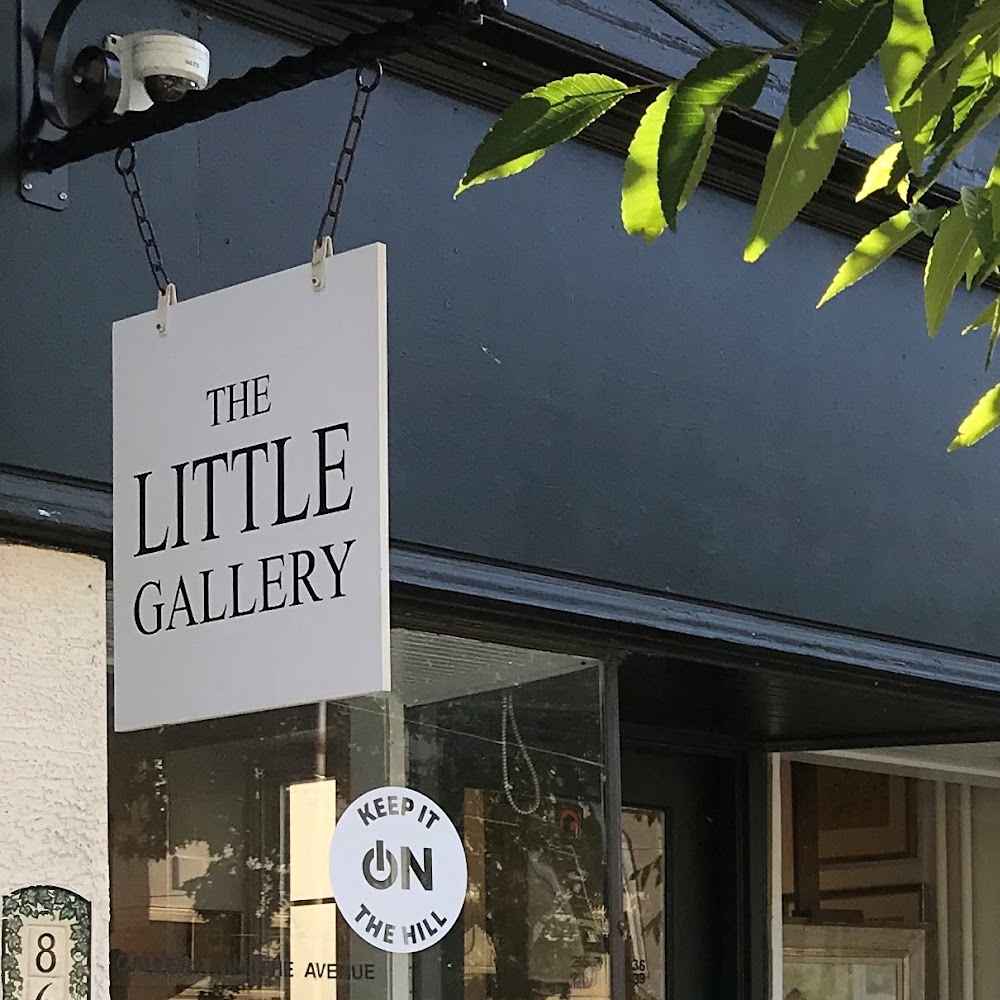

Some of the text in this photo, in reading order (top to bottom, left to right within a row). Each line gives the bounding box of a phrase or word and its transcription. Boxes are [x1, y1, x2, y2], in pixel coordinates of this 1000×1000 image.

[206, 374, 272, 427] THE
[133, 422, 353, 557] LITTLE
[133, 539, 356, 635] GALLERY
[357, 795, 440, 829] KEEP IT
[362, 840, 433, 891] ON
[354, 904, 447, 945] THE HILL
